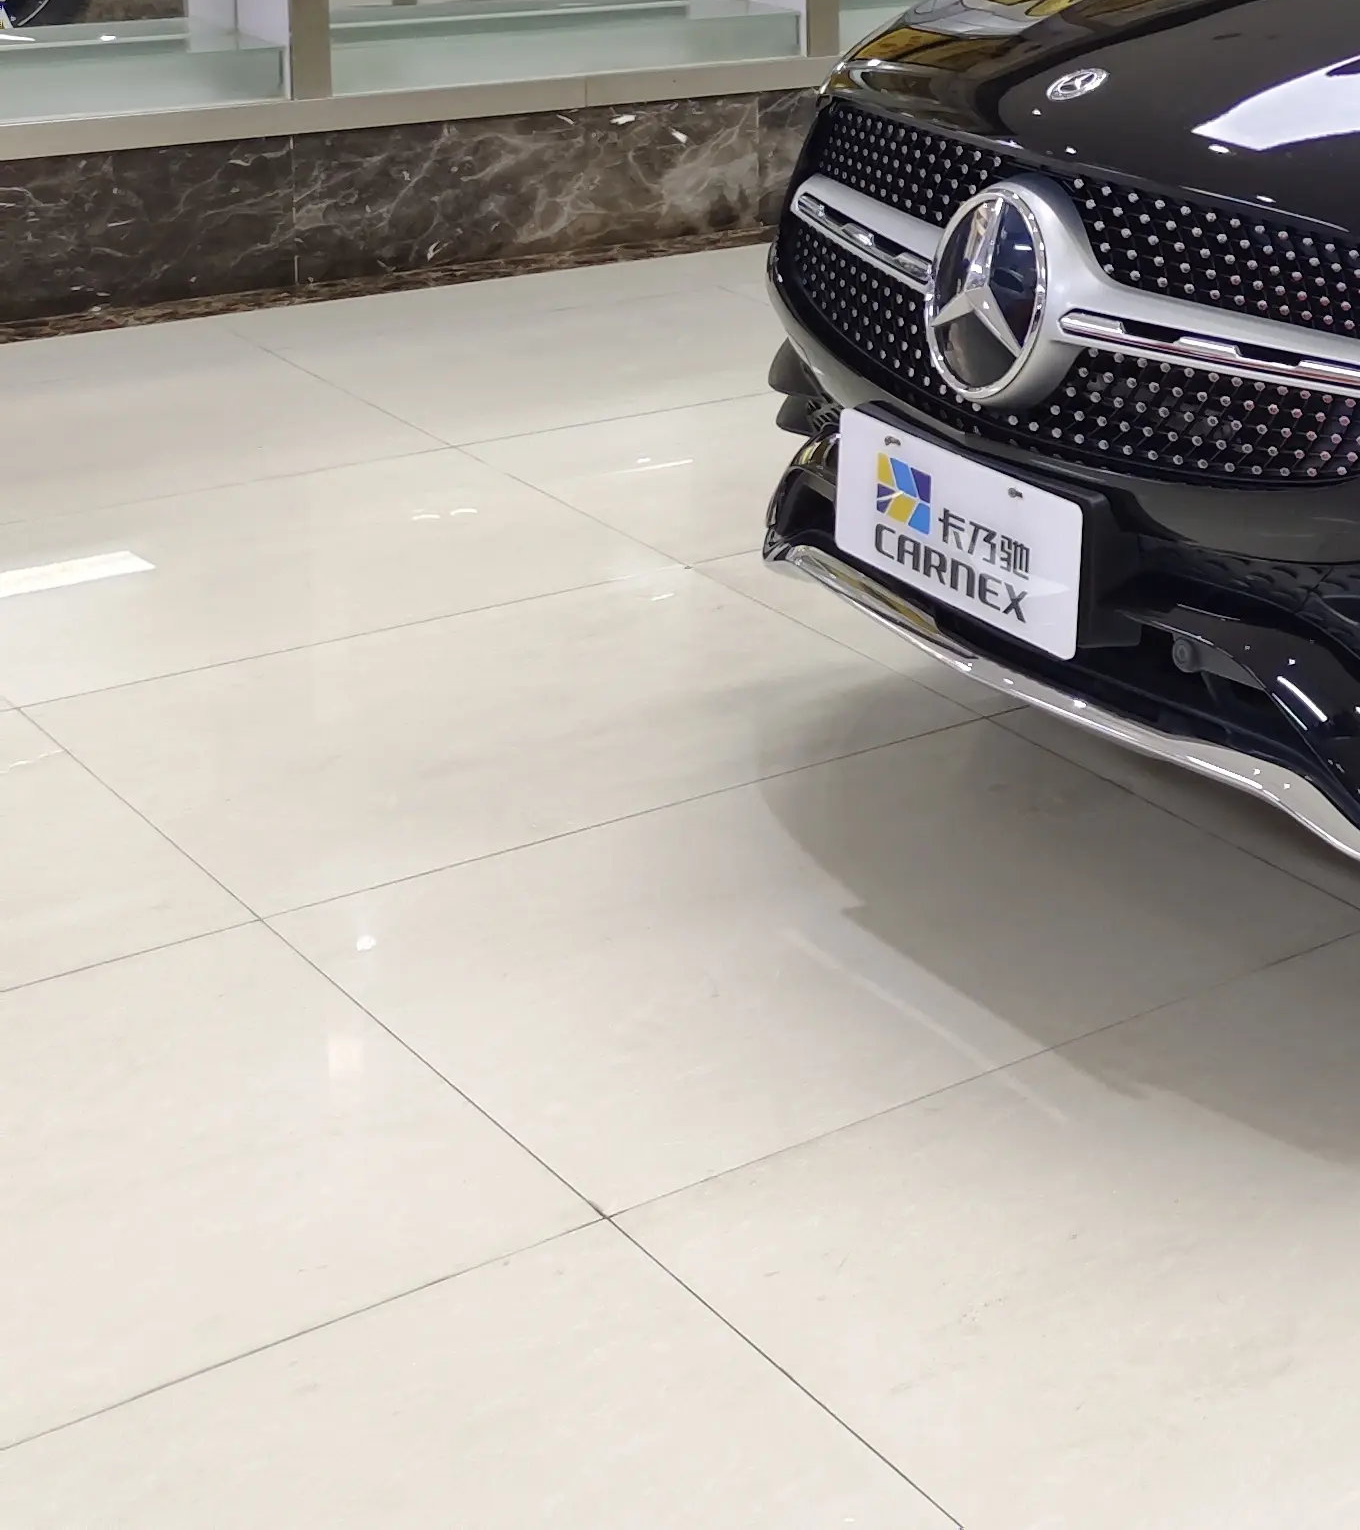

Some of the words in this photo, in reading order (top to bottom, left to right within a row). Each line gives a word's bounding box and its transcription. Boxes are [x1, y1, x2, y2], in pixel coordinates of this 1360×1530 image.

[874, 523, 1029, 624] CARNEX
[938, 507, 1031, 580] 卡乃驰
